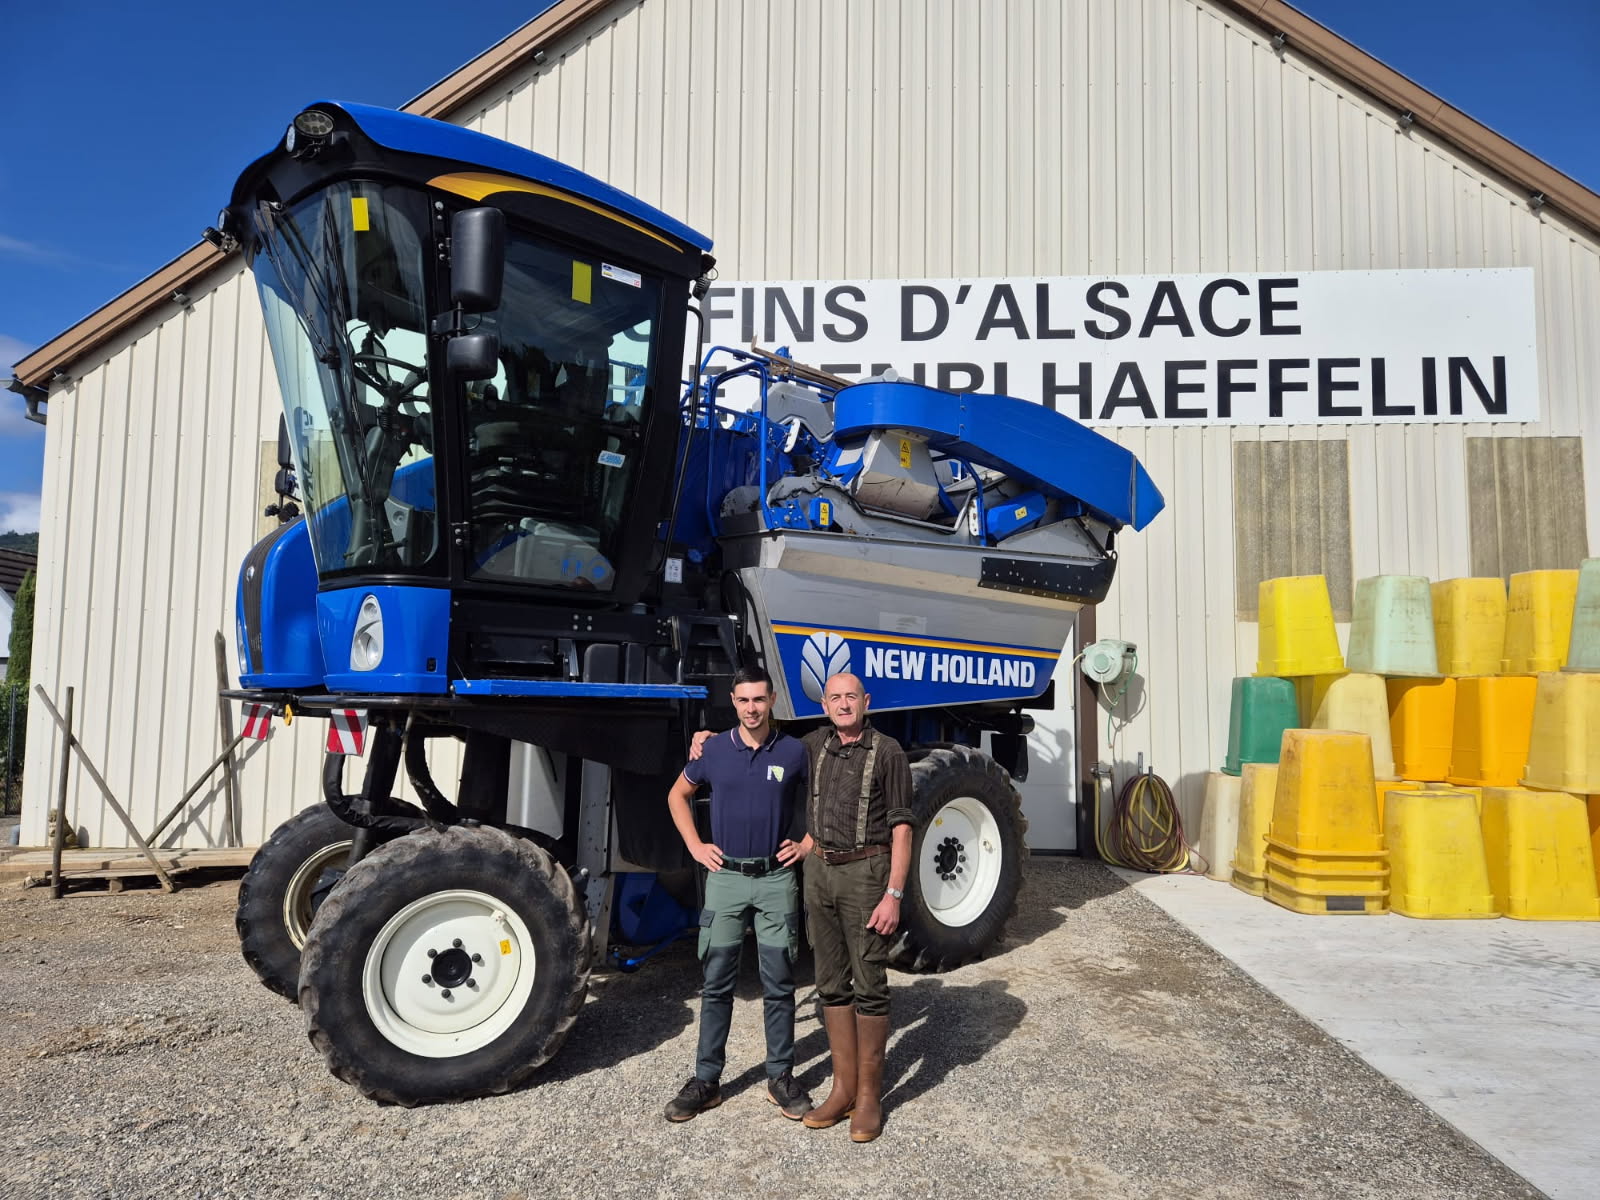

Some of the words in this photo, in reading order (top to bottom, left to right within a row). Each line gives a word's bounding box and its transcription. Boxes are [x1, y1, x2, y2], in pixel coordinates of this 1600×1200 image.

[701, 285, 868, 343] FINS
[900, 277, 1302, 342] D'ALSACE
[1042, 355, 1508, 420] HAEFFELIN
[865, 646, 925, 681] NEW
[931, 653, 1036, 688] HOLLAND
